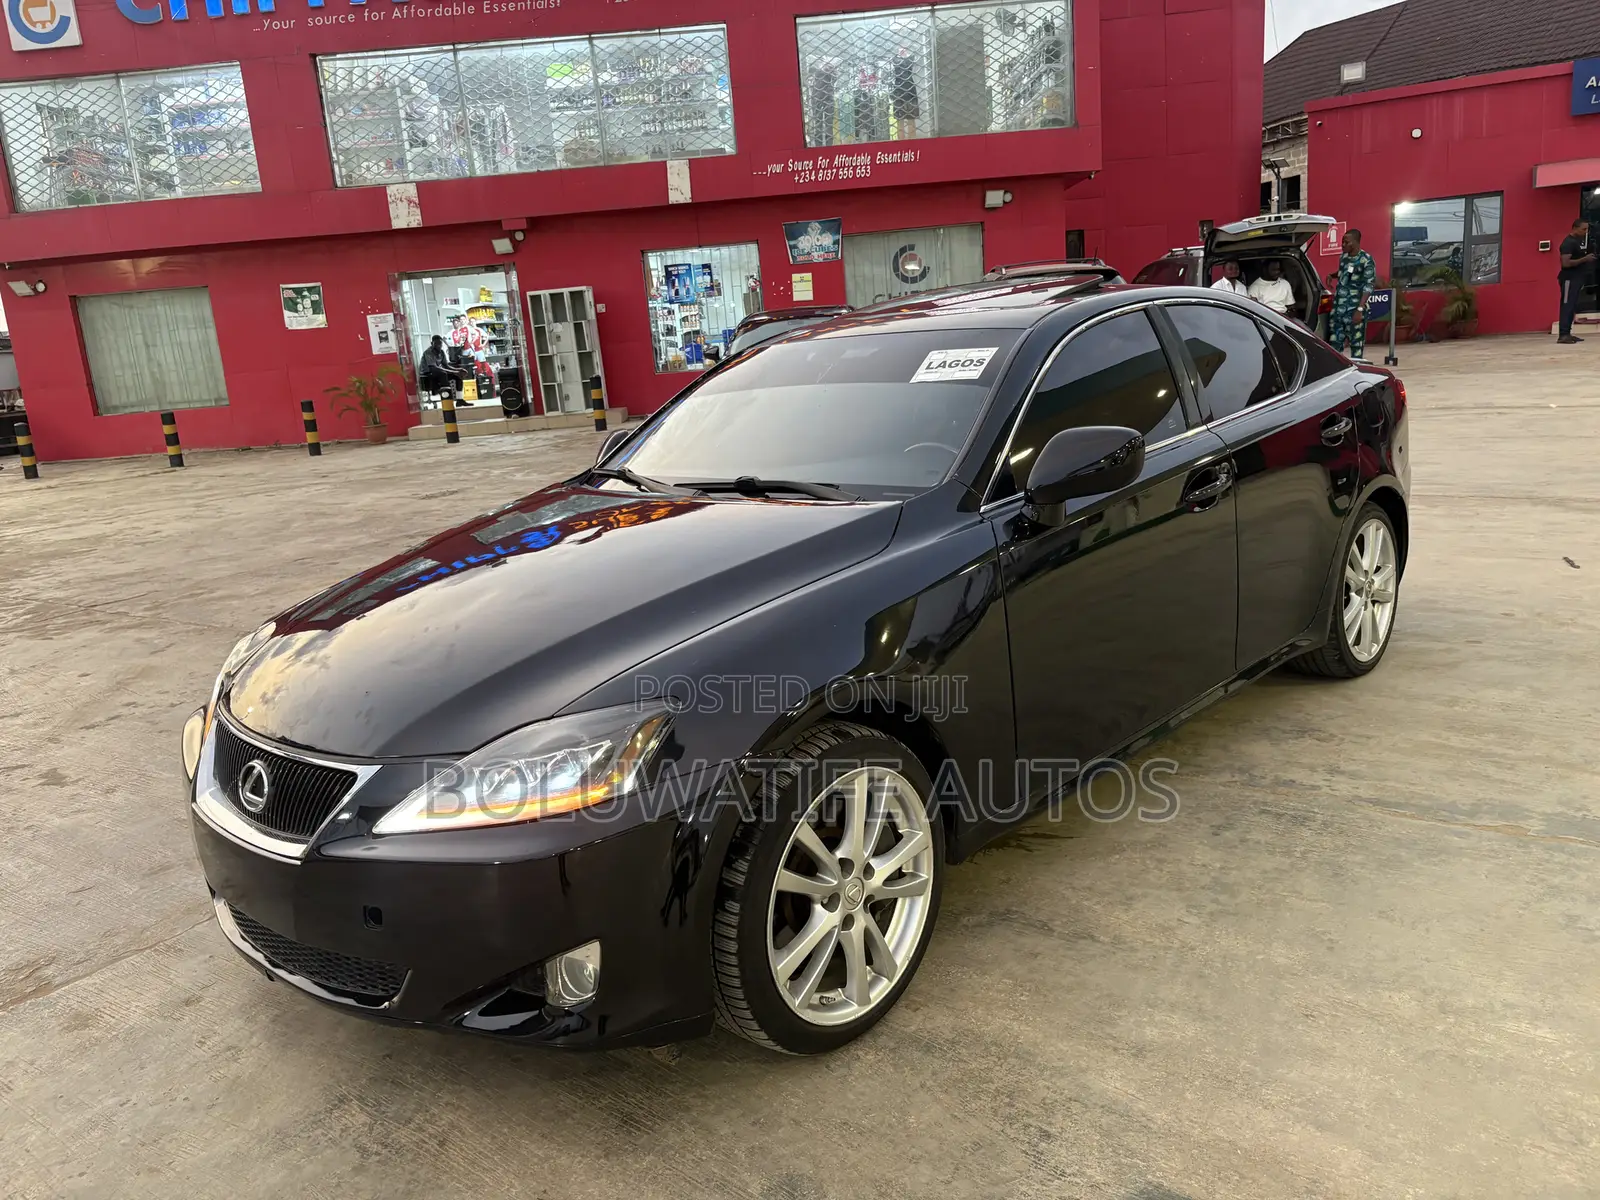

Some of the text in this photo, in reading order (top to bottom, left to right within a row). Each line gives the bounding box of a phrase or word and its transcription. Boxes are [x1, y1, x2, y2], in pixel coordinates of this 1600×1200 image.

[307, 13, 356, 27] source
[363, 9, 386, 21] for
[392, 2, 476, 19] Affordable
[483, 0, 561, 14] Essentials!
[788, 158, 814, 172] Source
[817, 156, 830, 169] For
[833, 153, 871, 168] Affordable
[794, 171, 816, 183] +234
[817, 169, 836, 181] 8137
[856, 166, 871, 177] 653
[1368, 294, 1389, 303] KING
[925, 358, 986, 370] LAGOS
